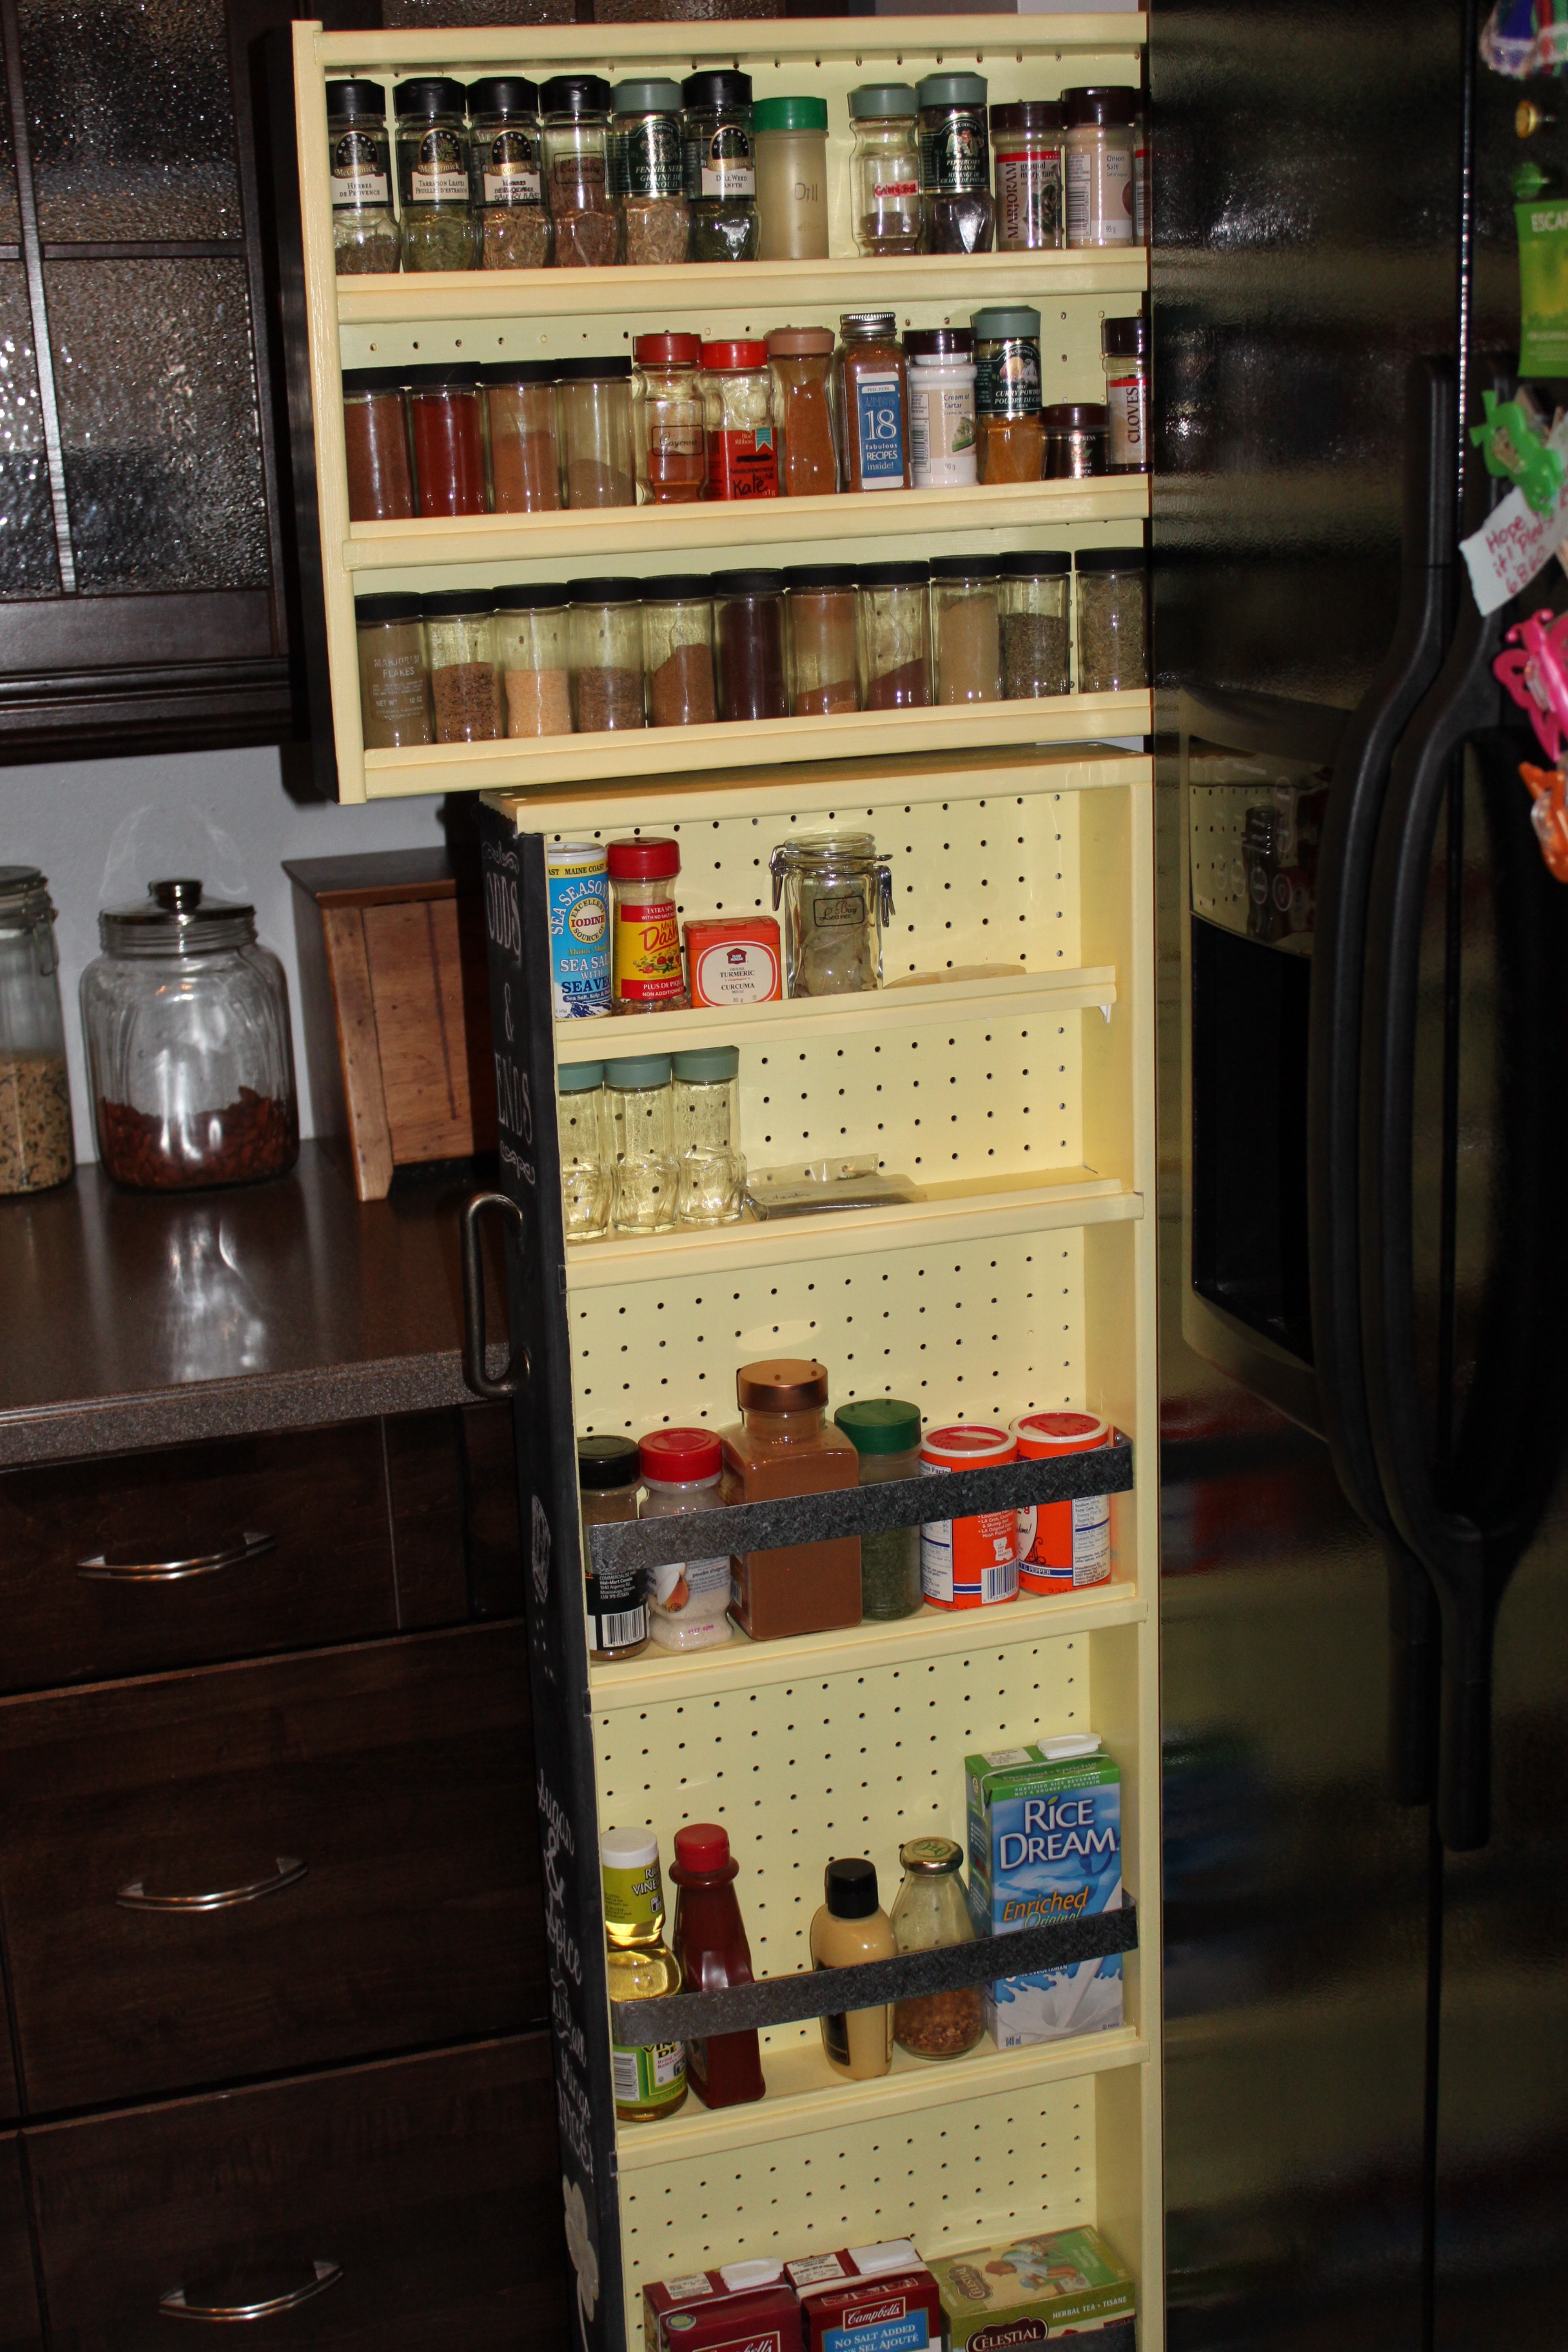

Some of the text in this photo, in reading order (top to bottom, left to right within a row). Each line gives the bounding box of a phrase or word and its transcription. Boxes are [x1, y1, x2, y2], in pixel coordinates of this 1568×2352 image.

[334, 165, 377, 177] McComick
[636, 165, 666, 174] FENNEL
[794, 182, 818, 202] Dill
[1006, 163, 1019, 238] MARJORAM
[1126, 387, 1141, 444] CLOVES
[865, 409, 897, 441] 18
[659, 432, 698, 447] Cayenne
[866, 451, 898, 461] RECIPES
[867, 462, 894, 471] inside!
[1485, 515, 1526, 555] Hope
[374, 655, 421, 668] MARJORM
[382, 666, 415, 679] FLAKES
[564, 866, 587, 875] MAINE
[588, 863, 604, 872] COAST
[486, 870, 521, 956] ODDS
[570, 898, 605, 918] EXCELLENT
[819, 907, 851, 920] Leaves
[834, 900, 858, 915] Bay
[551, 906, 567, 936] SEA
[571, 915, 605, 928] IODINE
[573, 927, 600, 941] SOURCE
[638, 919, 679, 952] Dash
[560, 958, 589, 973] SEA
[581, 969, 604, 979] WITH
[719, 970, 755, 978] TURMERIC
[504, 982, 514, 1043] &
[494, 1051, 532, 1146] ENDS
[692, 1569, 709, 1578] poudre
[1028, 1565, 1051, 1575] PEPPER
[1015, 1783, 1047, 1792] FORTIFIED
[1067, 1776, 1100, 1784] BEVERAGE
[1073, 1780, 1100, 1788] PROTEIN
[537, 1768, 574, 1857] sugar
[1000, 1827, 1117, 1870] DREAM
[632, 1880, 658, 1896] VINE
[1002, 1886, 1090, 1923] Enriched
[545, 1891, 582, 1986] spice
[847, 2302, 900, 2325] Campbell's
[1052, 2296, 1127, 2319] HERBAL TEA TISANE
[835, 2324, 916, 2349] NO SALT ADDED
[858, 2333, 919, 2352] SEL AJOUTÉ
[973, 2327, 1041, 2352] CELESTIAL
